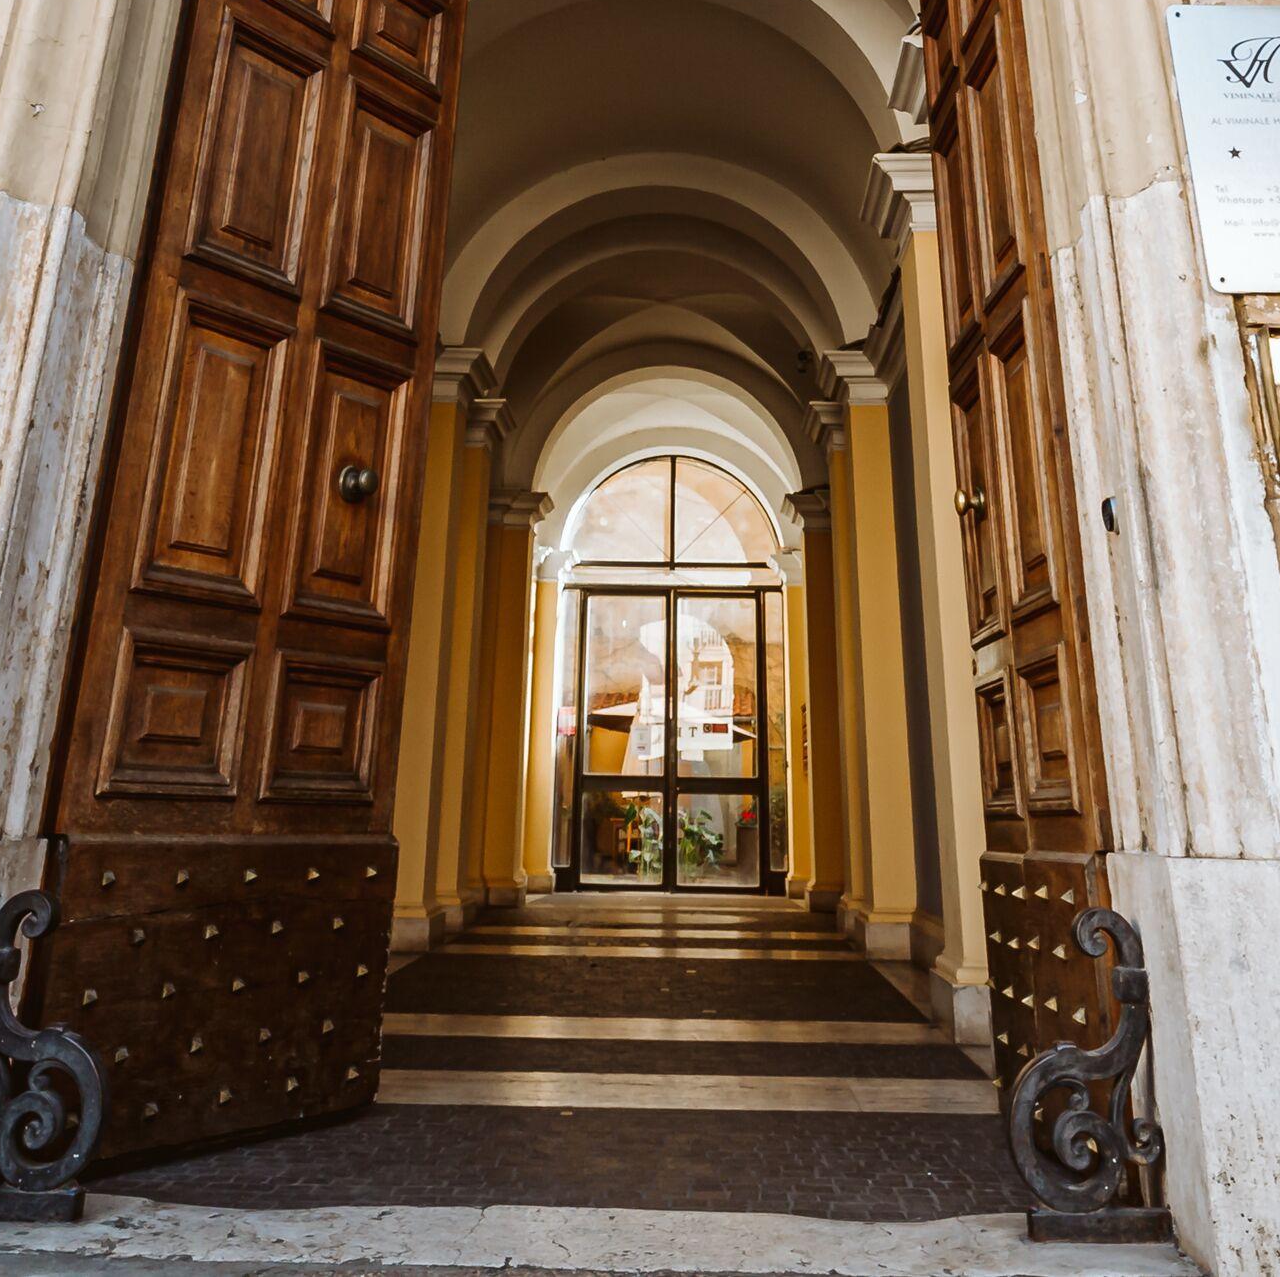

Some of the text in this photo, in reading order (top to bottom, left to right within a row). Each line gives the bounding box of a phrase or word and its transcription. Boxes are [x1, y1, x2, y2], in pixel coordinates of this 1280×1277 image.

[1223, 92, 1273, 100] VIMINALE
[1210, 117, 1222, 125] AL
[1225, 117, 1269, 125] VIMINALE
